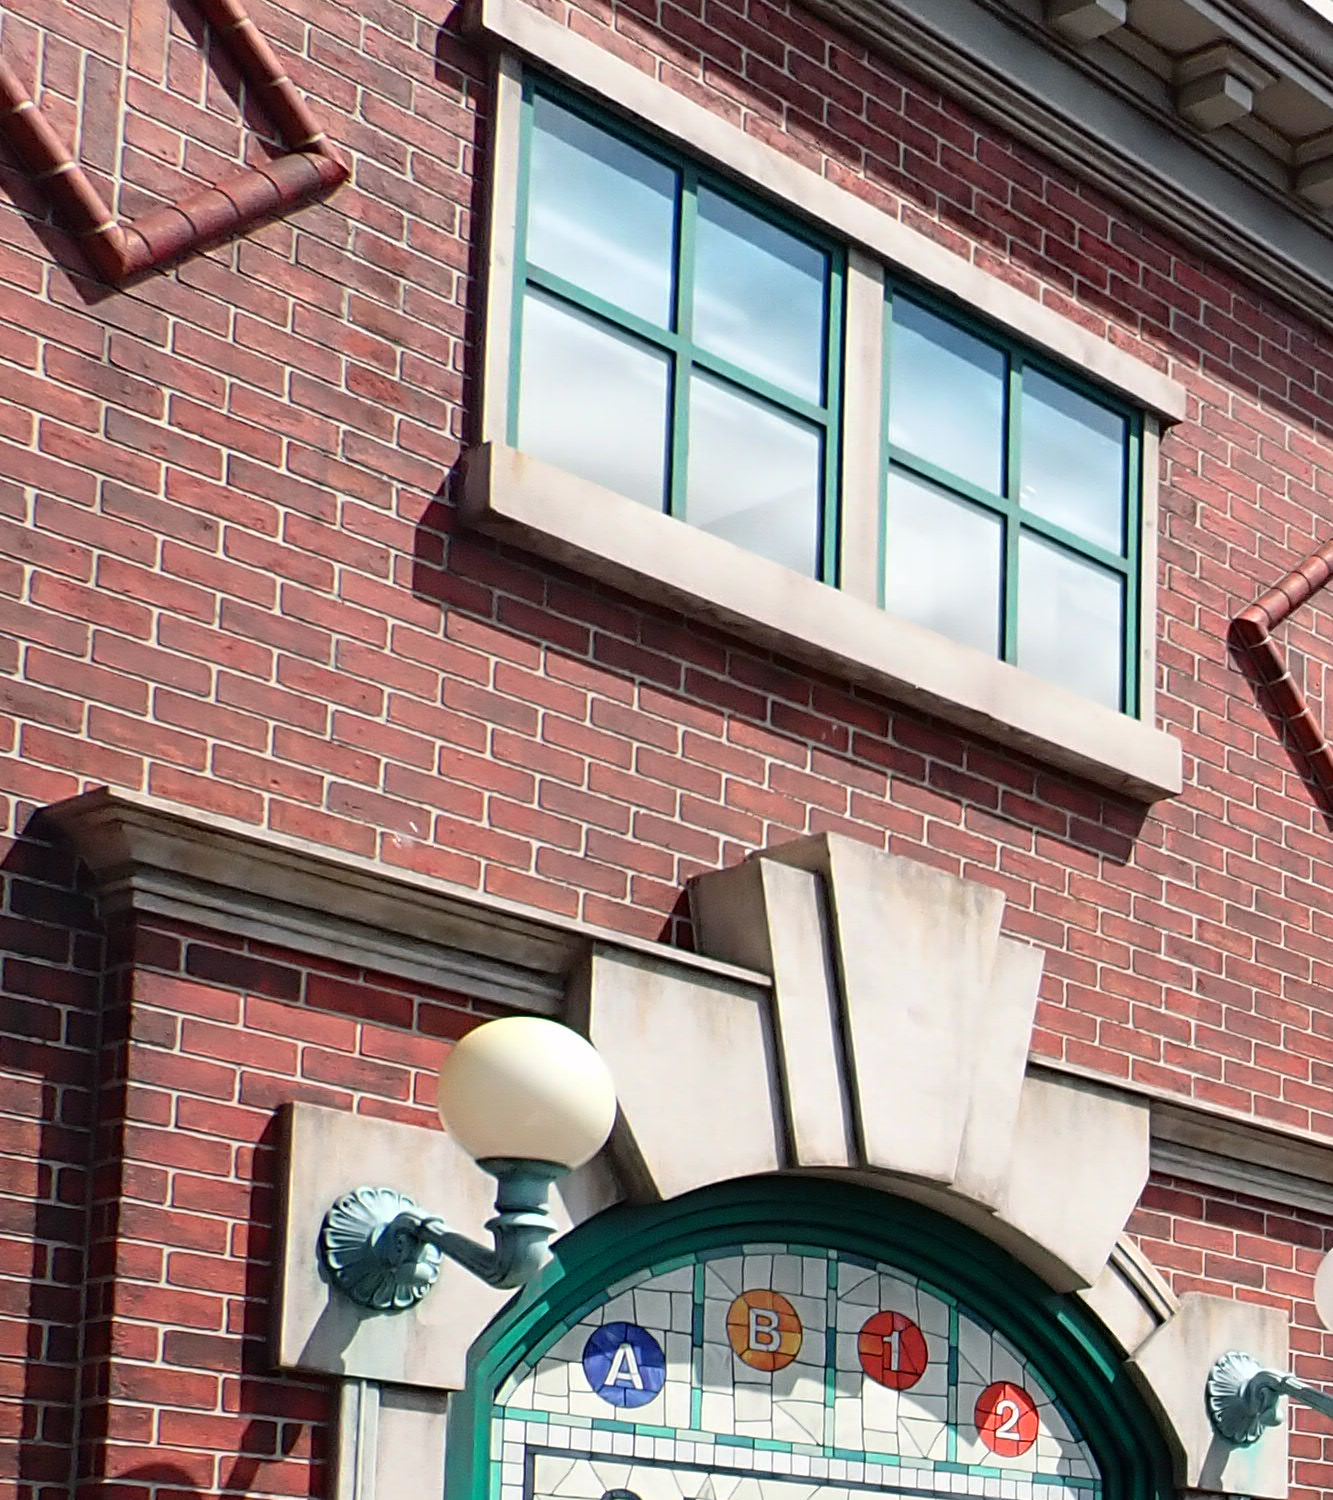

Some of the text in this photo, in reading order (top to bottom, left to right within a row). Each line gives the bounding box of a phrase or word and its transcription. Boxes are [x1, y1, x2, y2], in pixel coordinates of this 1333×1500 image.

[603, 1305, 1023, 1442] A B 1 2
